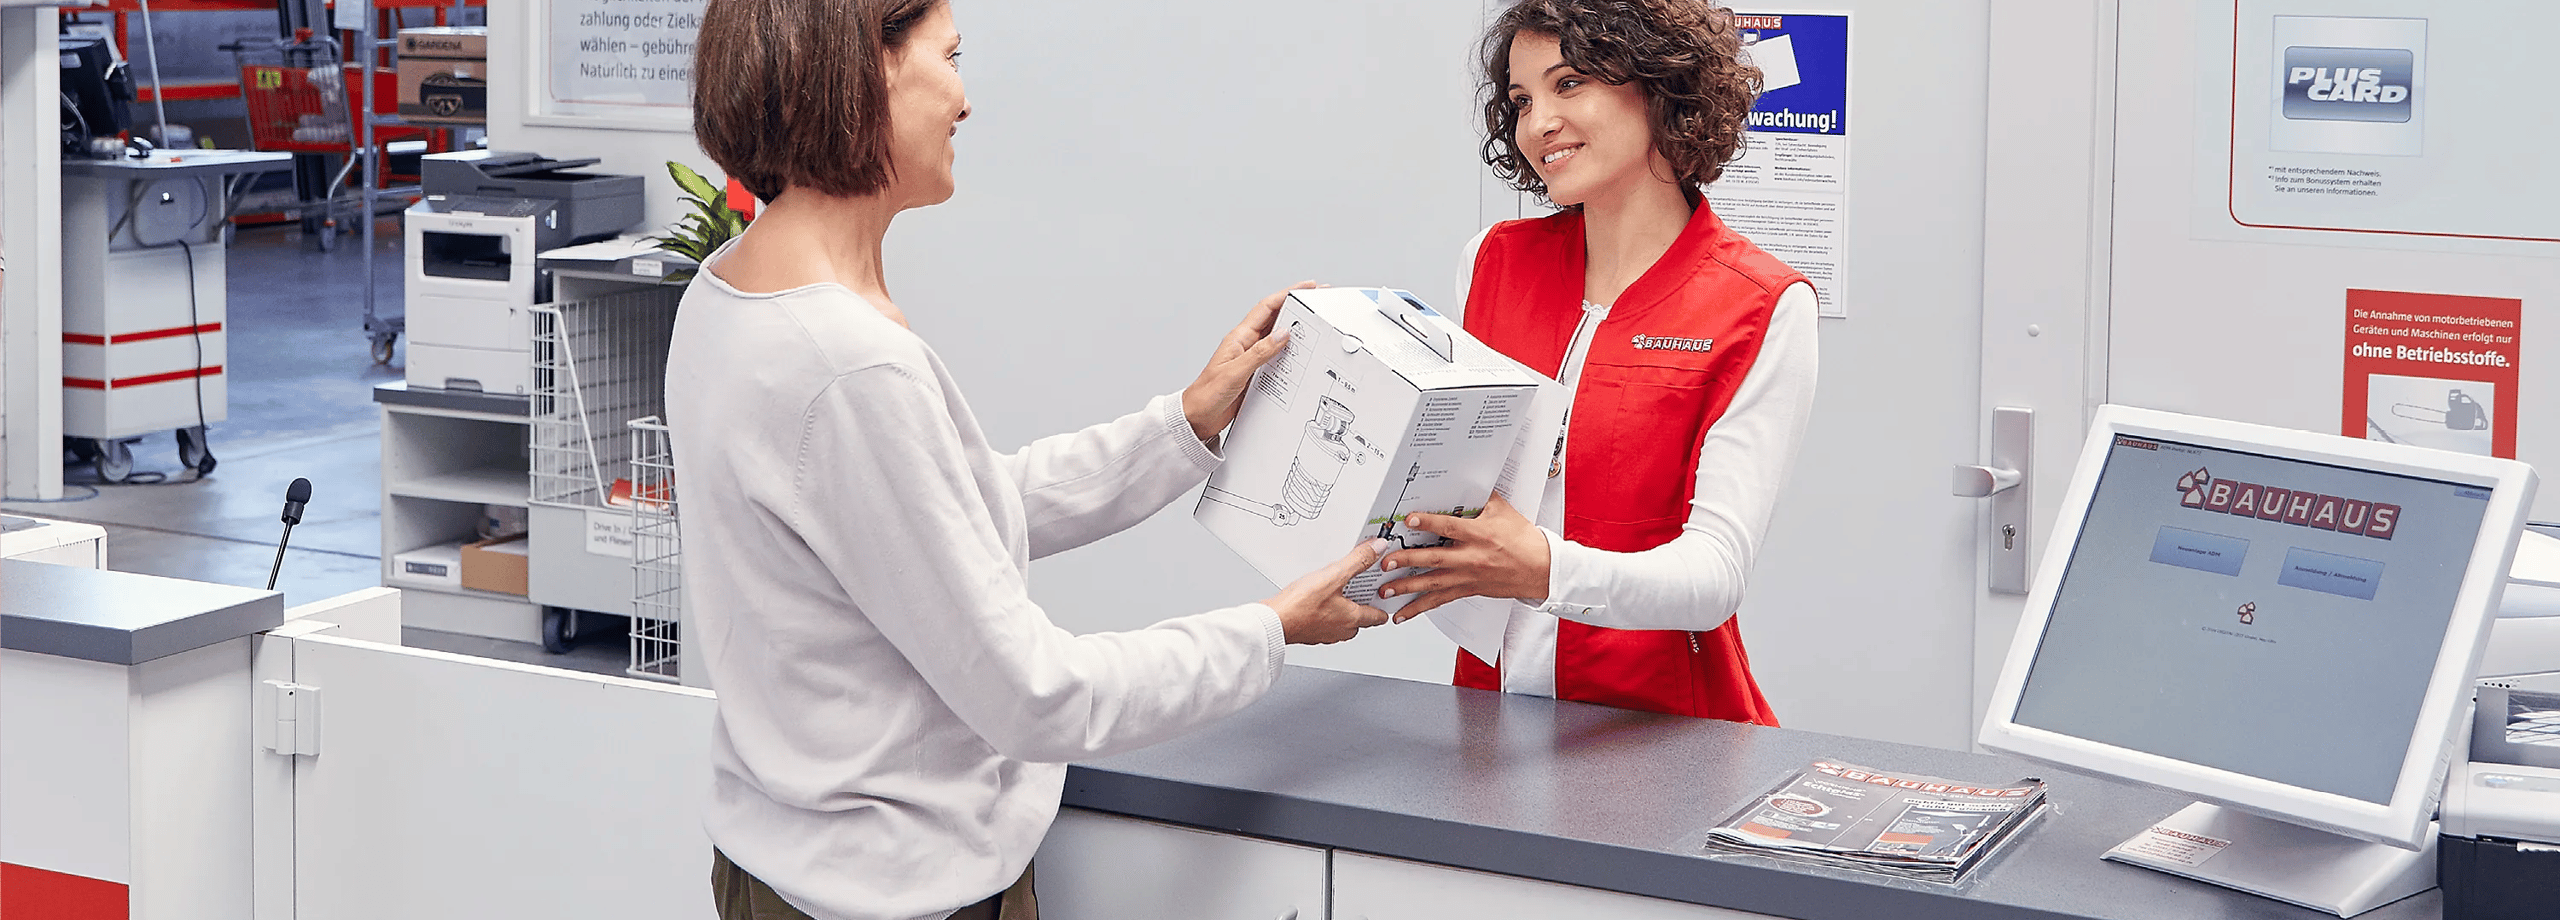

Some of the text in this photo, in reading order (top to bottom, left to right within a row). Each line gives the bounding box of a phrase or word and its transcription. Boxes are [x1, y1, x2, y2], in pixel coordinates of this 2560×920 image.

[580, 11, 630, 31] zahlung
[634, 13, 663, 28] oder
[1734, 16, 1782, 28] UHAUS
[580, 37, 627, 53] wählen
[641, 67, 655, 80] zu
[2288, 67, 2382, 86] PLUS
[2307, 82, 2408, 104] CARD
[1748, 108, 1837, 133] wachung!
[2288, 167, 2345, 176] entsprechendem
[2352, 179, 2382, 187] erhalten
[2353, 309, 2514, 329] Die Annahme von motorbetriebenen
[2353, 324, 2513, 345] Geräten und Maschinen erfolgt nur
[1645, 338, 1713, 352] BAUHAUS
[2352, 342, 2510, 368] ohne Betriebsstoffe.
[2123, 439, 2158, 450] BAUHAUS
[2209, 482, 2395, 534] BAUHAUS
[1842, 769, 2032, 798] BAUHAUS
